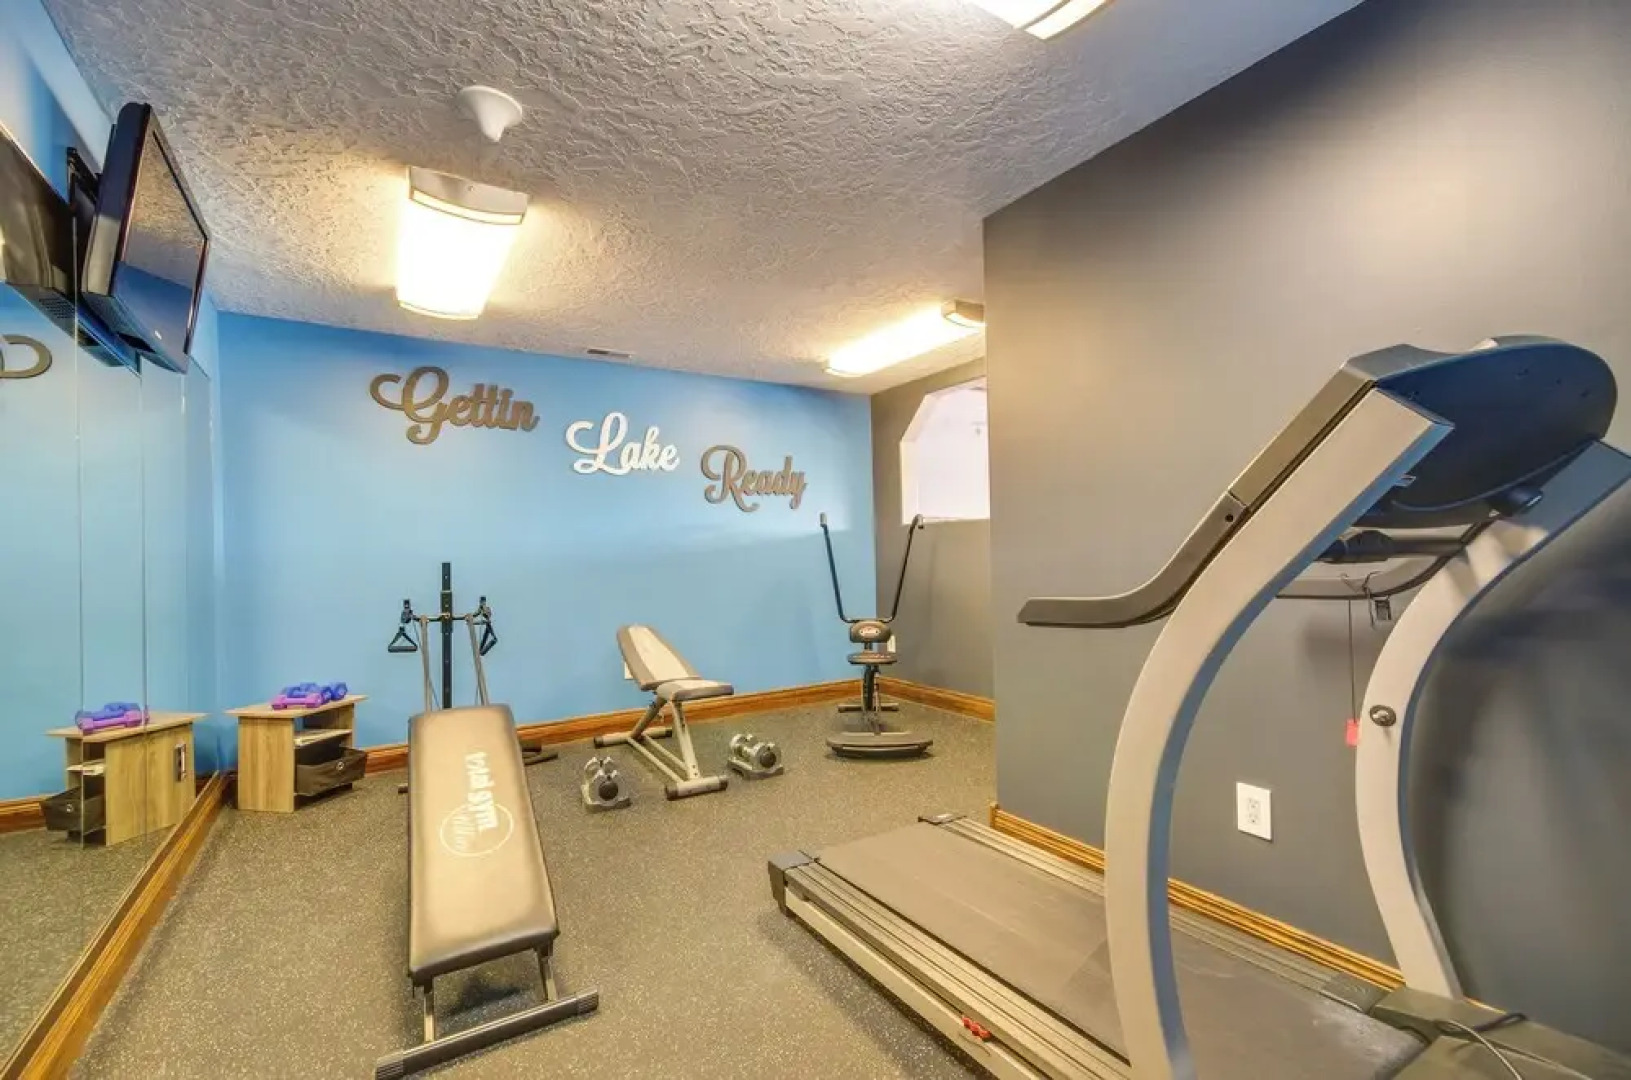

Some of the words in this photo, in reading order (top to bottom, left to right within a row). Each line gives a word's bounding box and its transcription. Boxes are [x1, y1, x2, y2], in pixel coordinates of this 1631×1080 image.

[369, 366, 540, 445] Gettin
[565, 412, 681, 476] Lake
[700, 444, 808, 512] Ready
